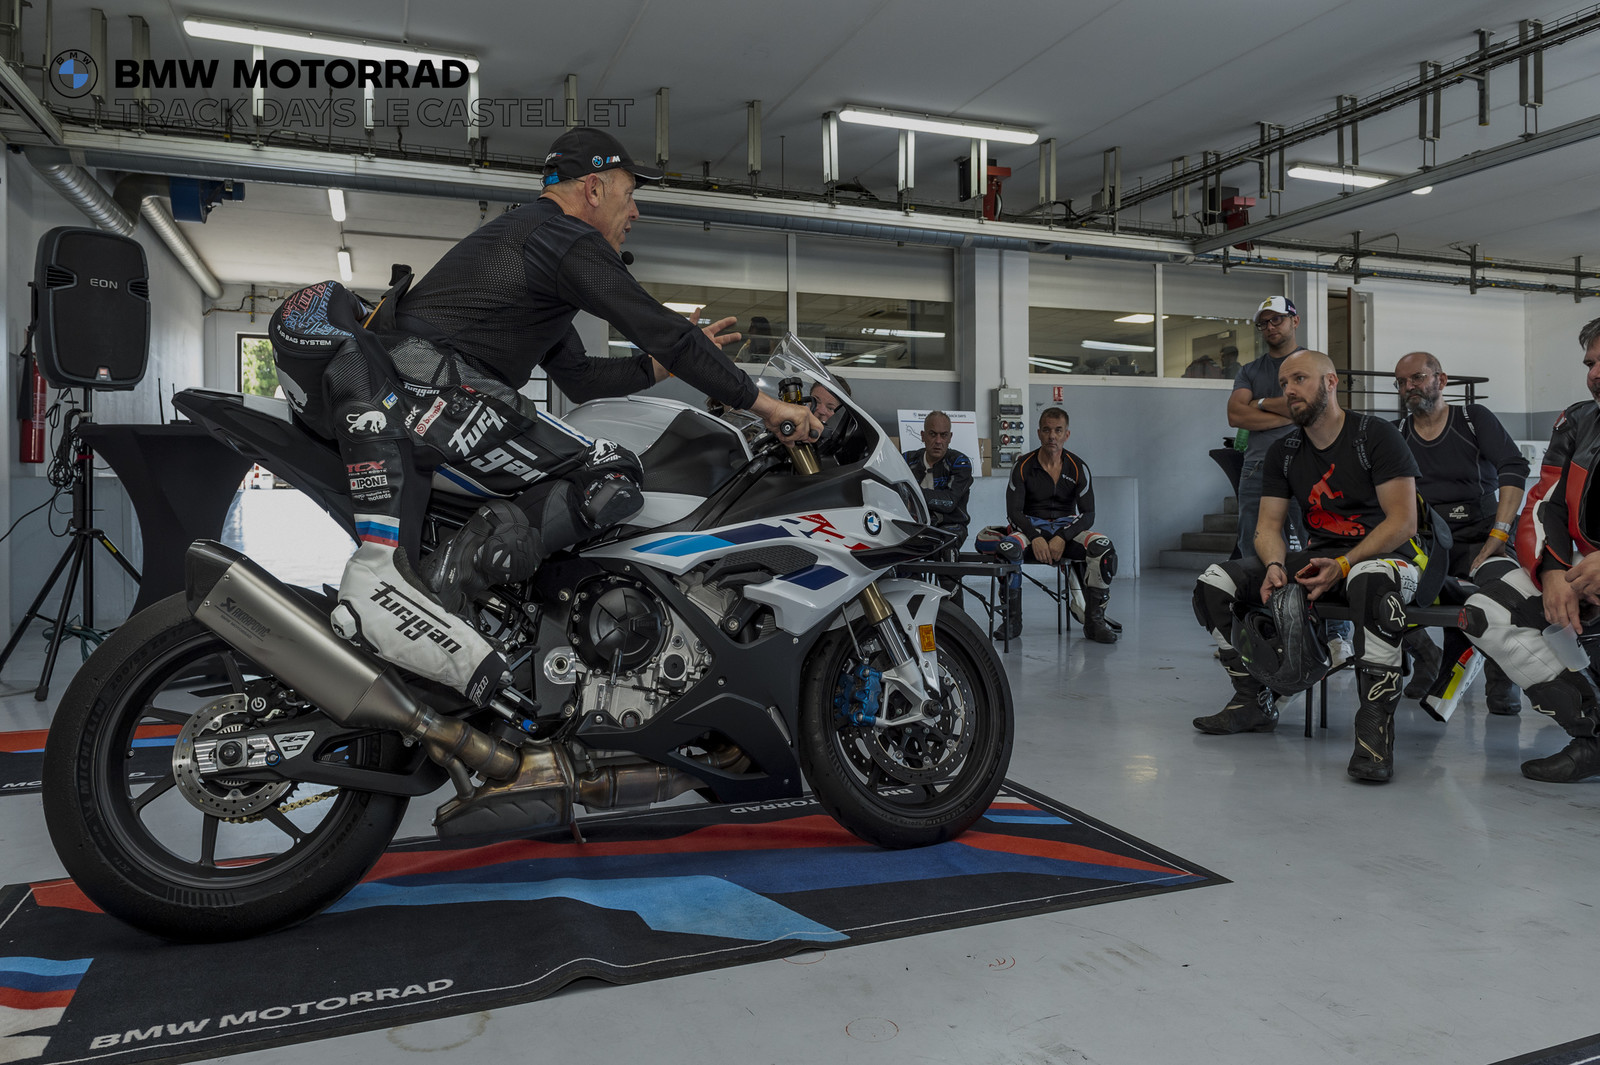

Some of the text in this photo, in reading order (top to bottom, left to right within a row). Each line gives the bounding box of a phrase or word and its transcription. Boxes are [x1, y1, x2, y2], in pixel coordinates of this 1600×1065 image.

[89, 278, 119, 289] EON
[346, 459, 385, 472] TCX
[356, 475, 387, 488] IPONE
[79, 699, 106, 796] MICHELIN
[729, 799, 821, 815] TORRAD
[89, 978, 454, 1051] BMW MOTORRAD
